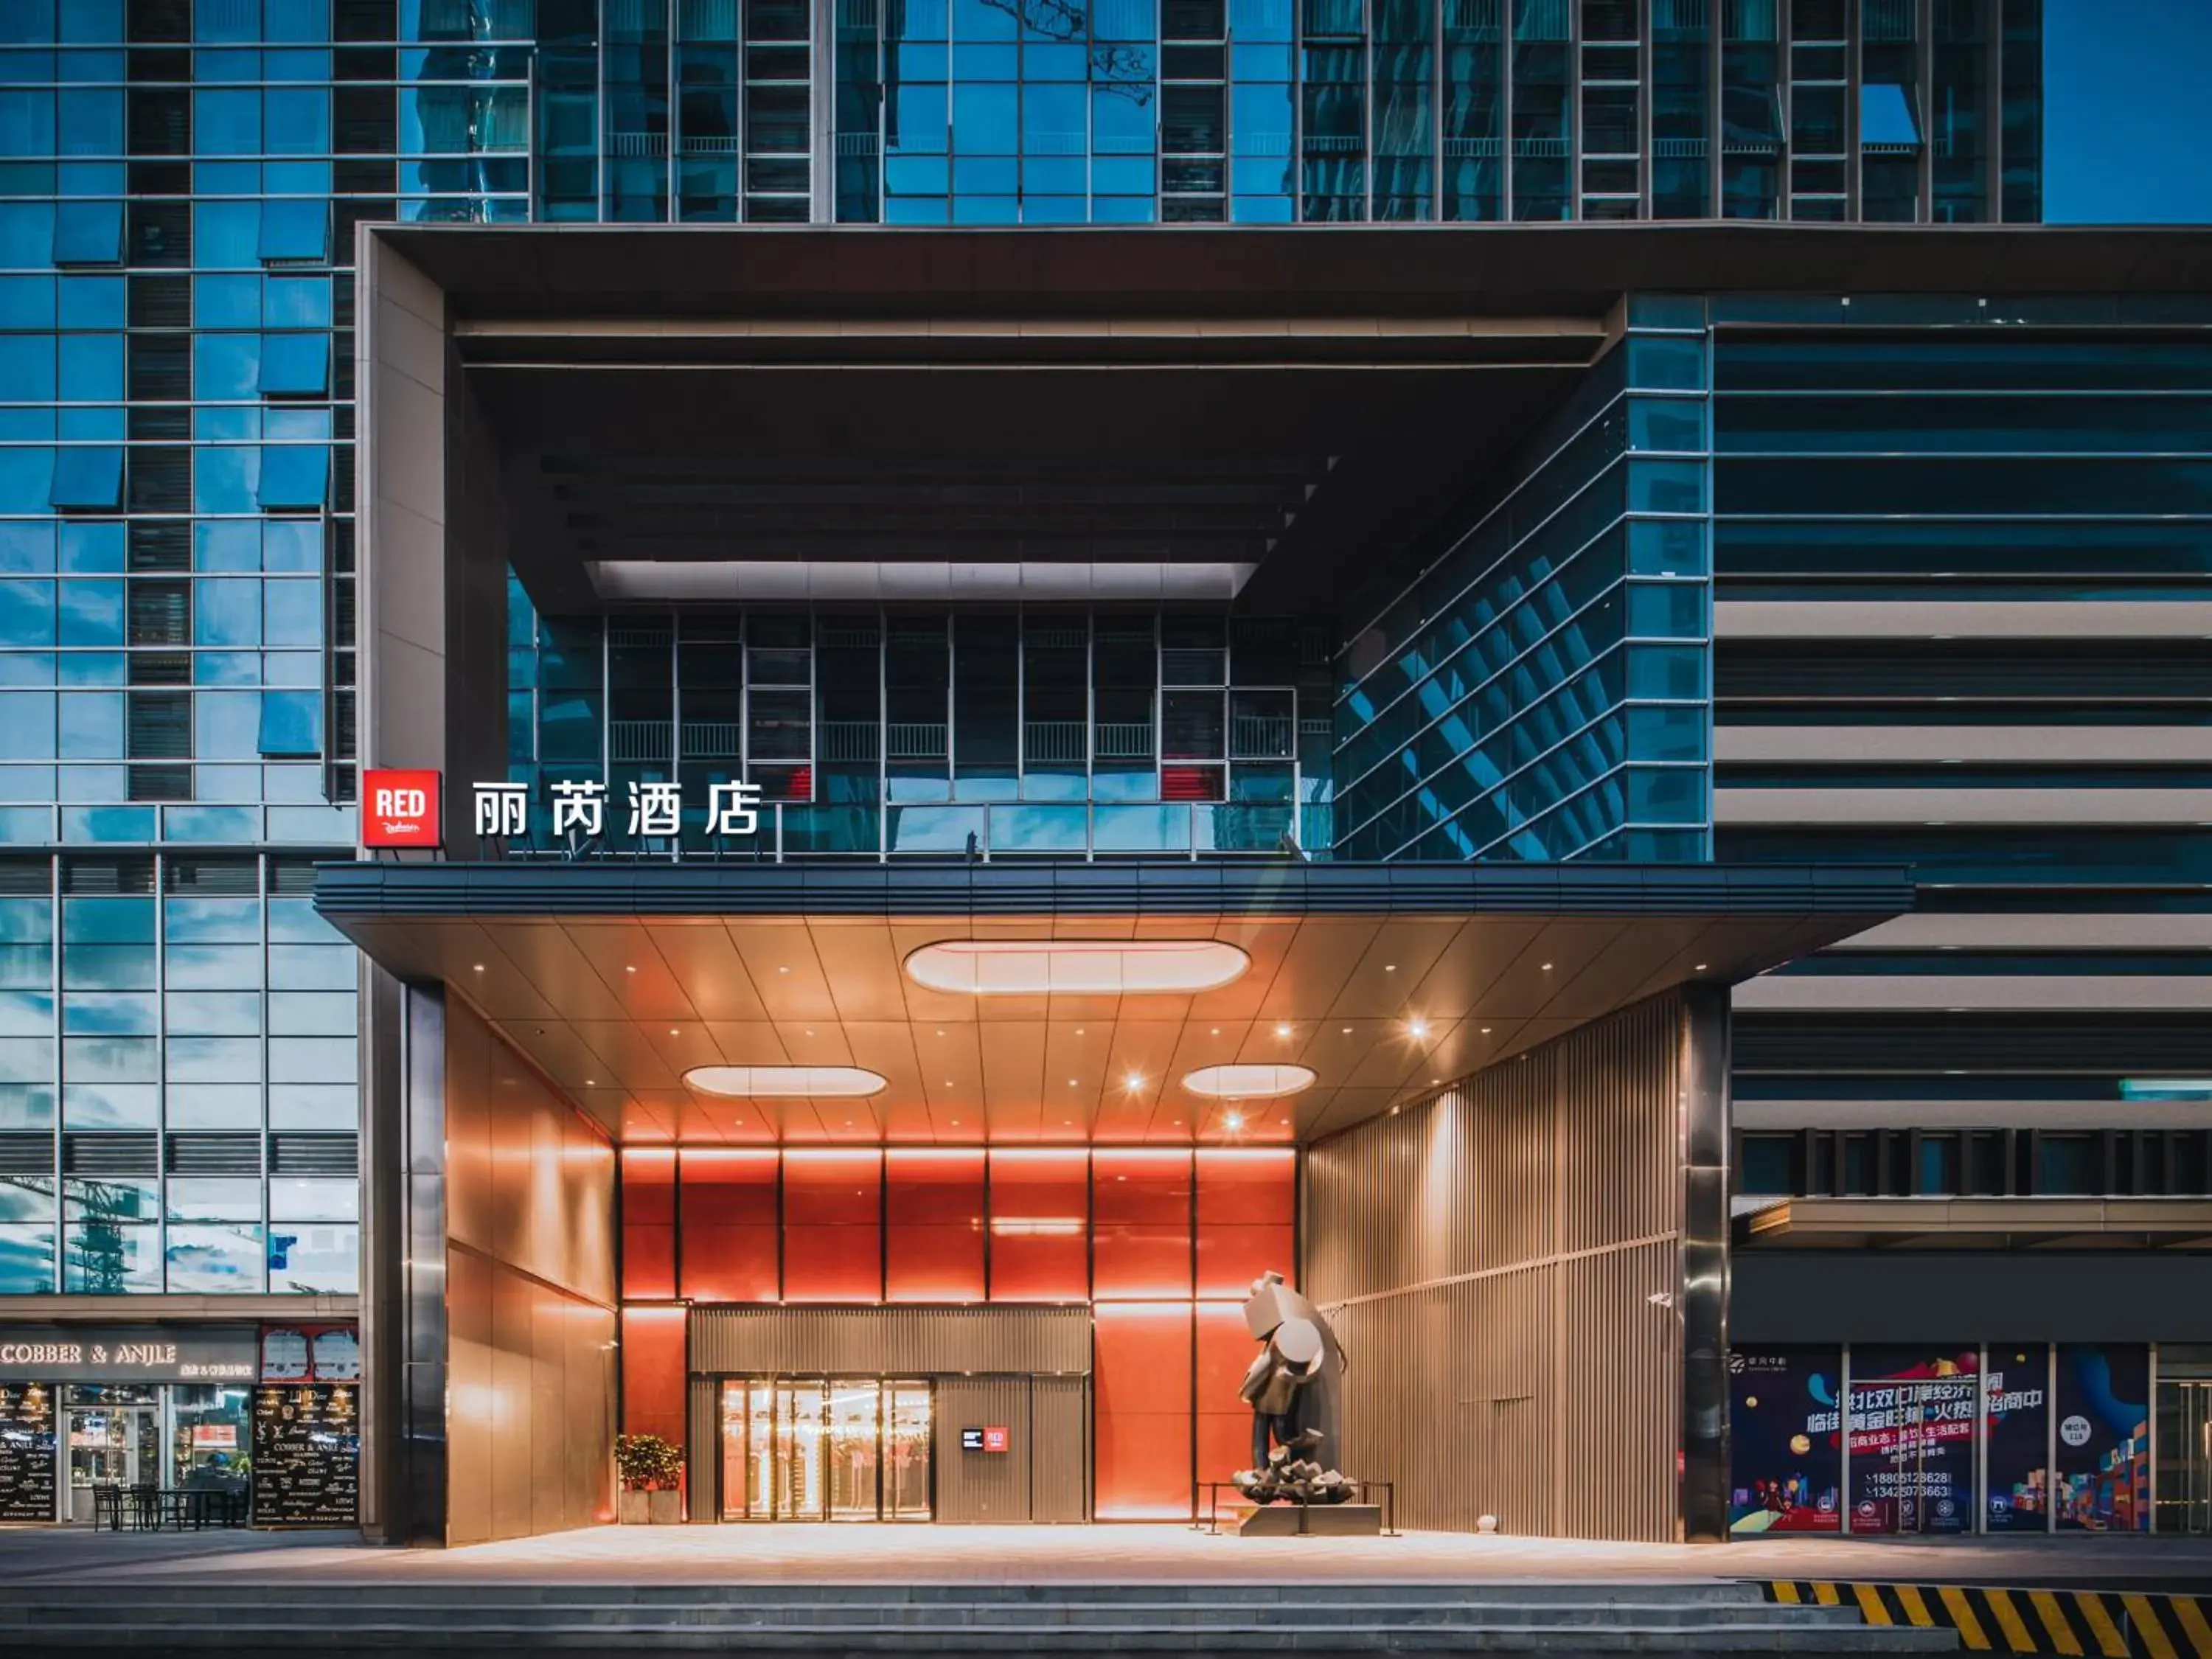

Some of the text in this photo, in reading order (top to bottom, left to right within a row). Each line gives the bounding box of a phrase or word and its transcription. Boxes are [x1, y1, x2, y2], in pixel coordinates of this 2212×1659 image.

[376, 789, 425, 818] RED
[473, 779, 761, 835] 丽芮酒店
[1, 1343, 81, 1363] COBBER
[90, 1344, 108, 1363] &
